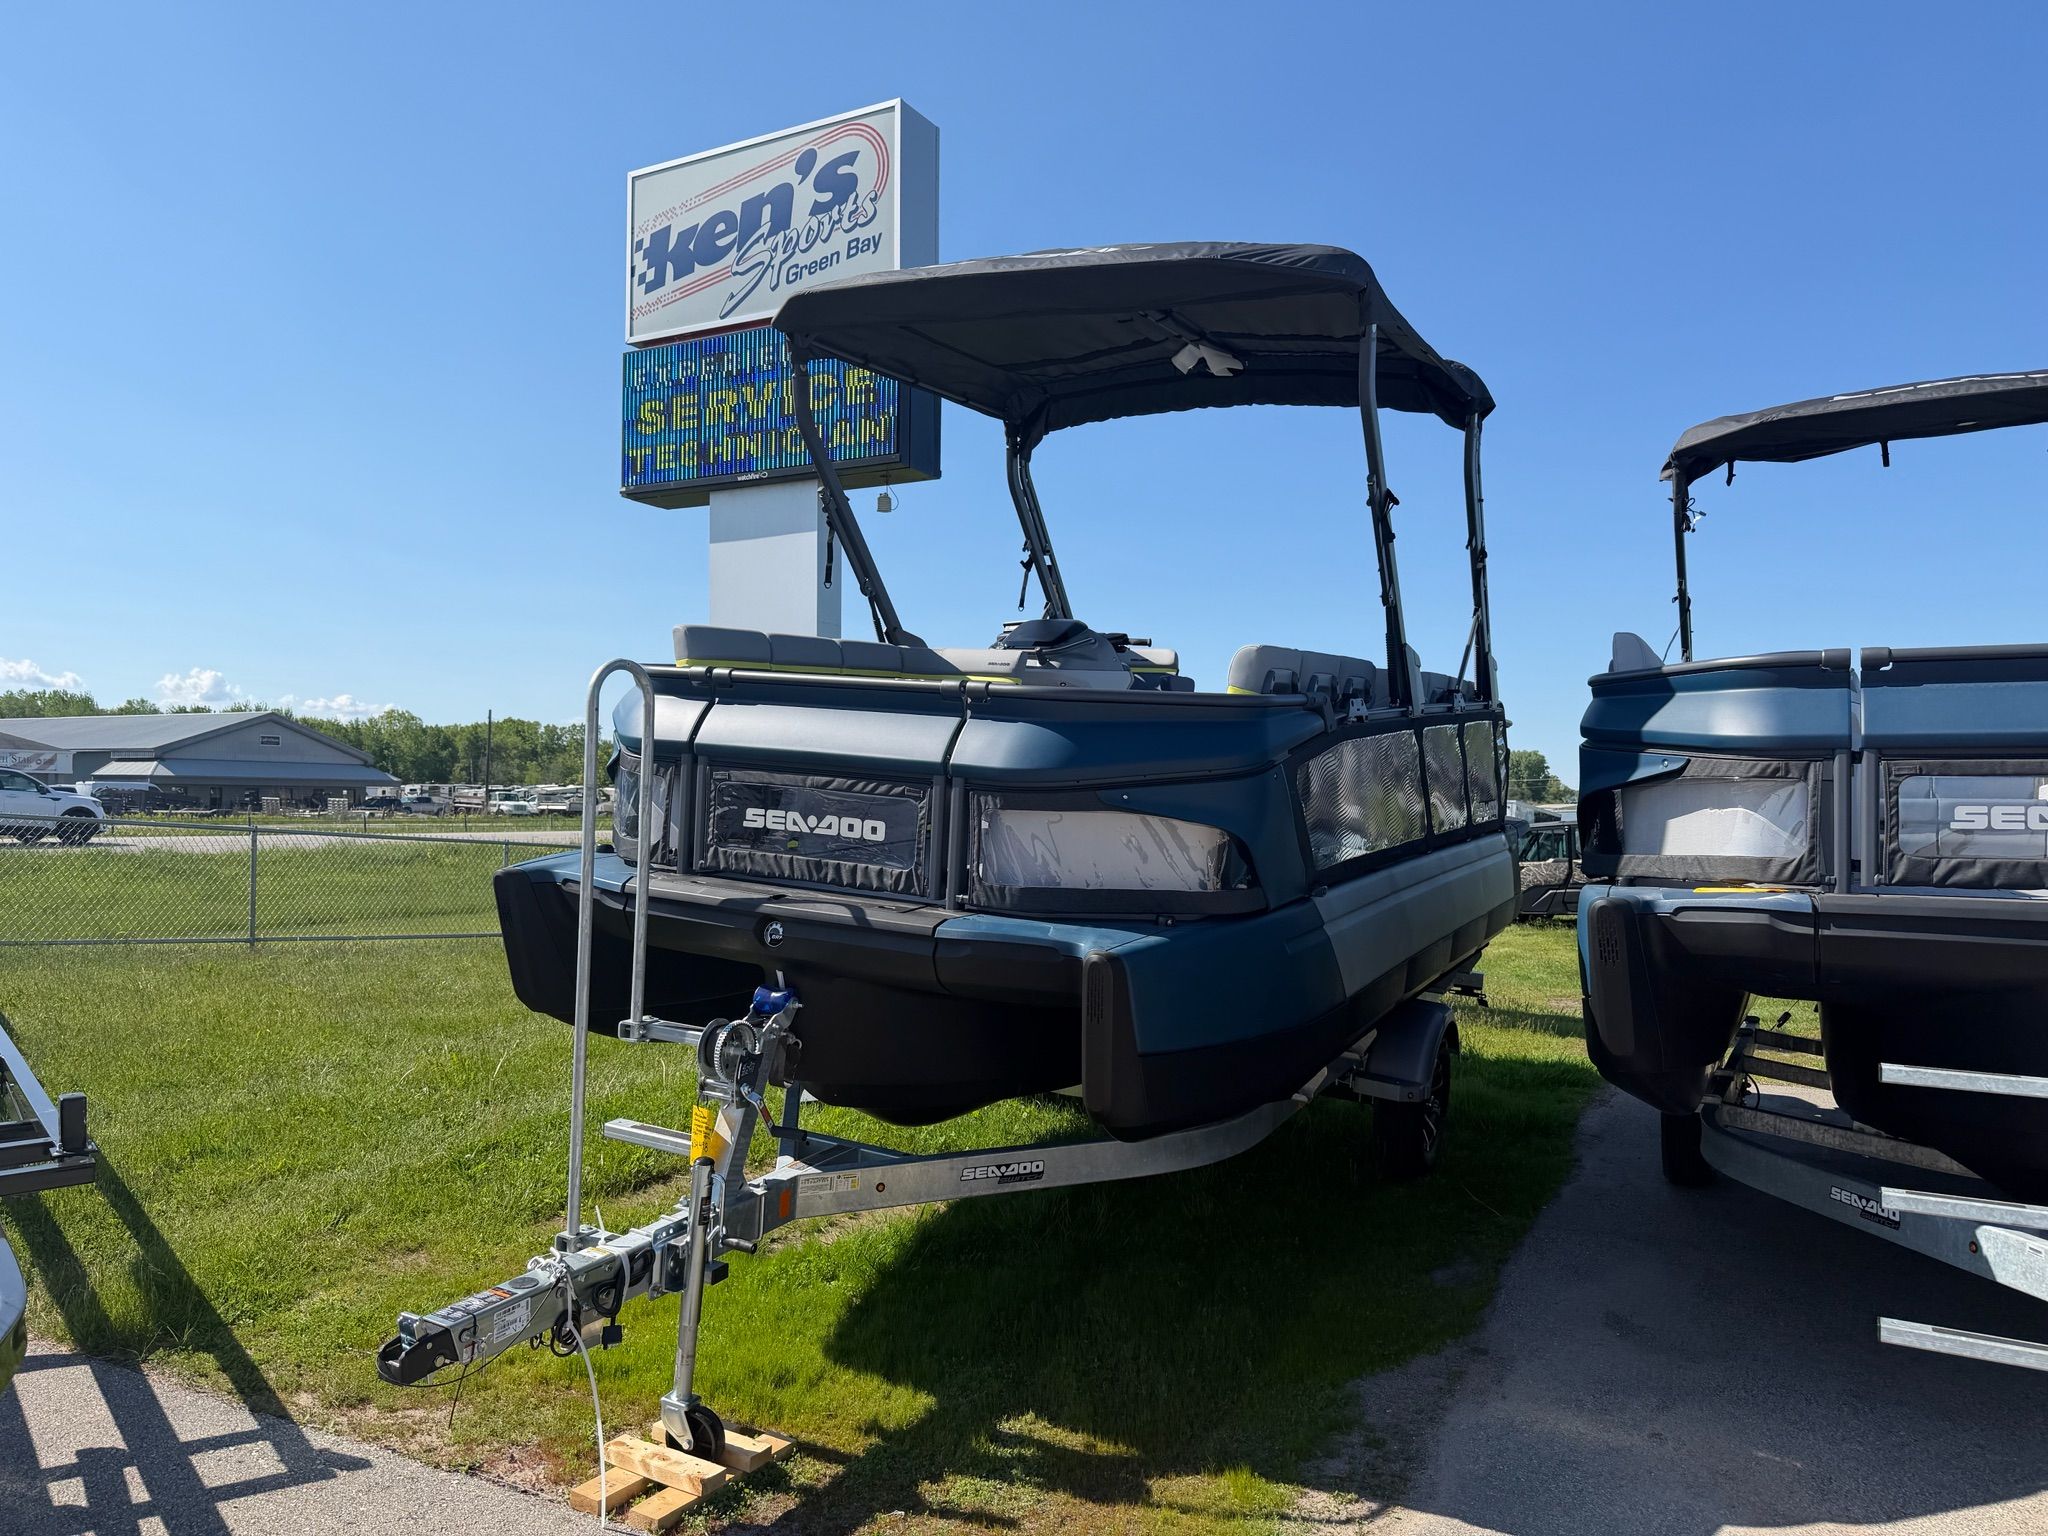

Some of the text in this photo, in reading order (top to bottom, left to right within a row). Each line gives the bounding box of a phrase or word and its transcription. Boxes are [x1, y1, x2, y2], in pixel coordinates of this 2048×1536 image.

[633, 147, 860, 295] ken's
[718, 189, 878, 320] Sports
[785, 232, 883, 286] Green Bay
[636, 367, 876, 436] SERVICE
